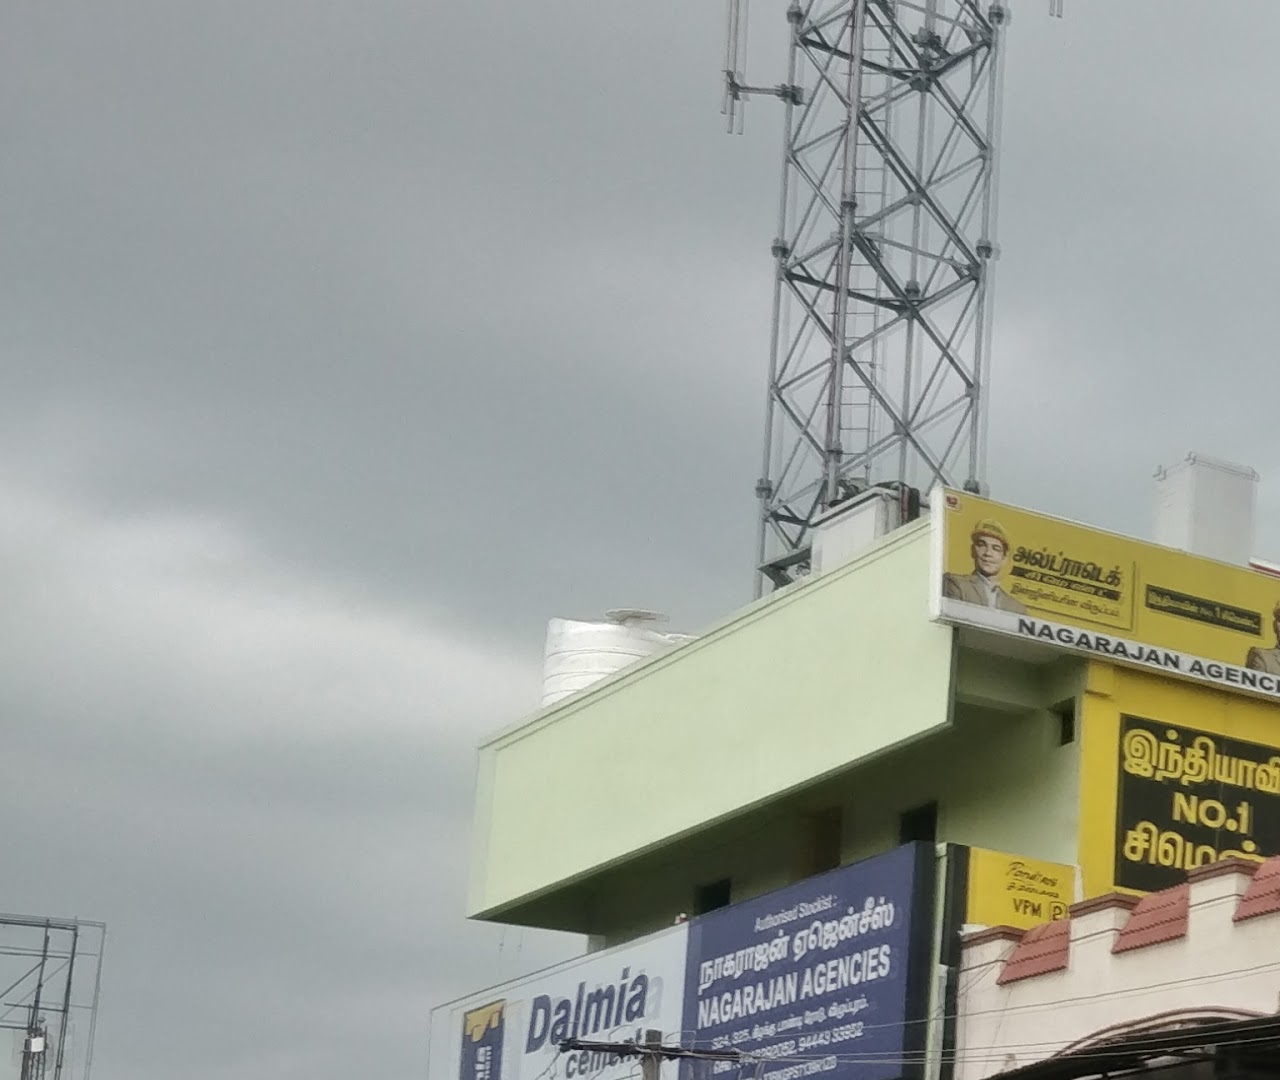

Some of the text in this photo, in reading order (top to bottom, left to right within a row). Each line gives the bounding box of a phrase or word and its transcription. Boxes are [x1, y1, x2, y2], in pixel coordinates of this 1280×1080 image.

[1018, 618, 1180, 670] NAGARAJAN
[1172, 791, 1251, 835] NO.1
[698, 897, 894, 995] நாகராஜன் ஏஜென்சீஸ்
[698, 944, 890, 1029] NAGARAJAN AGENCIES
[525, 966, 650, 1054] Dalmia
